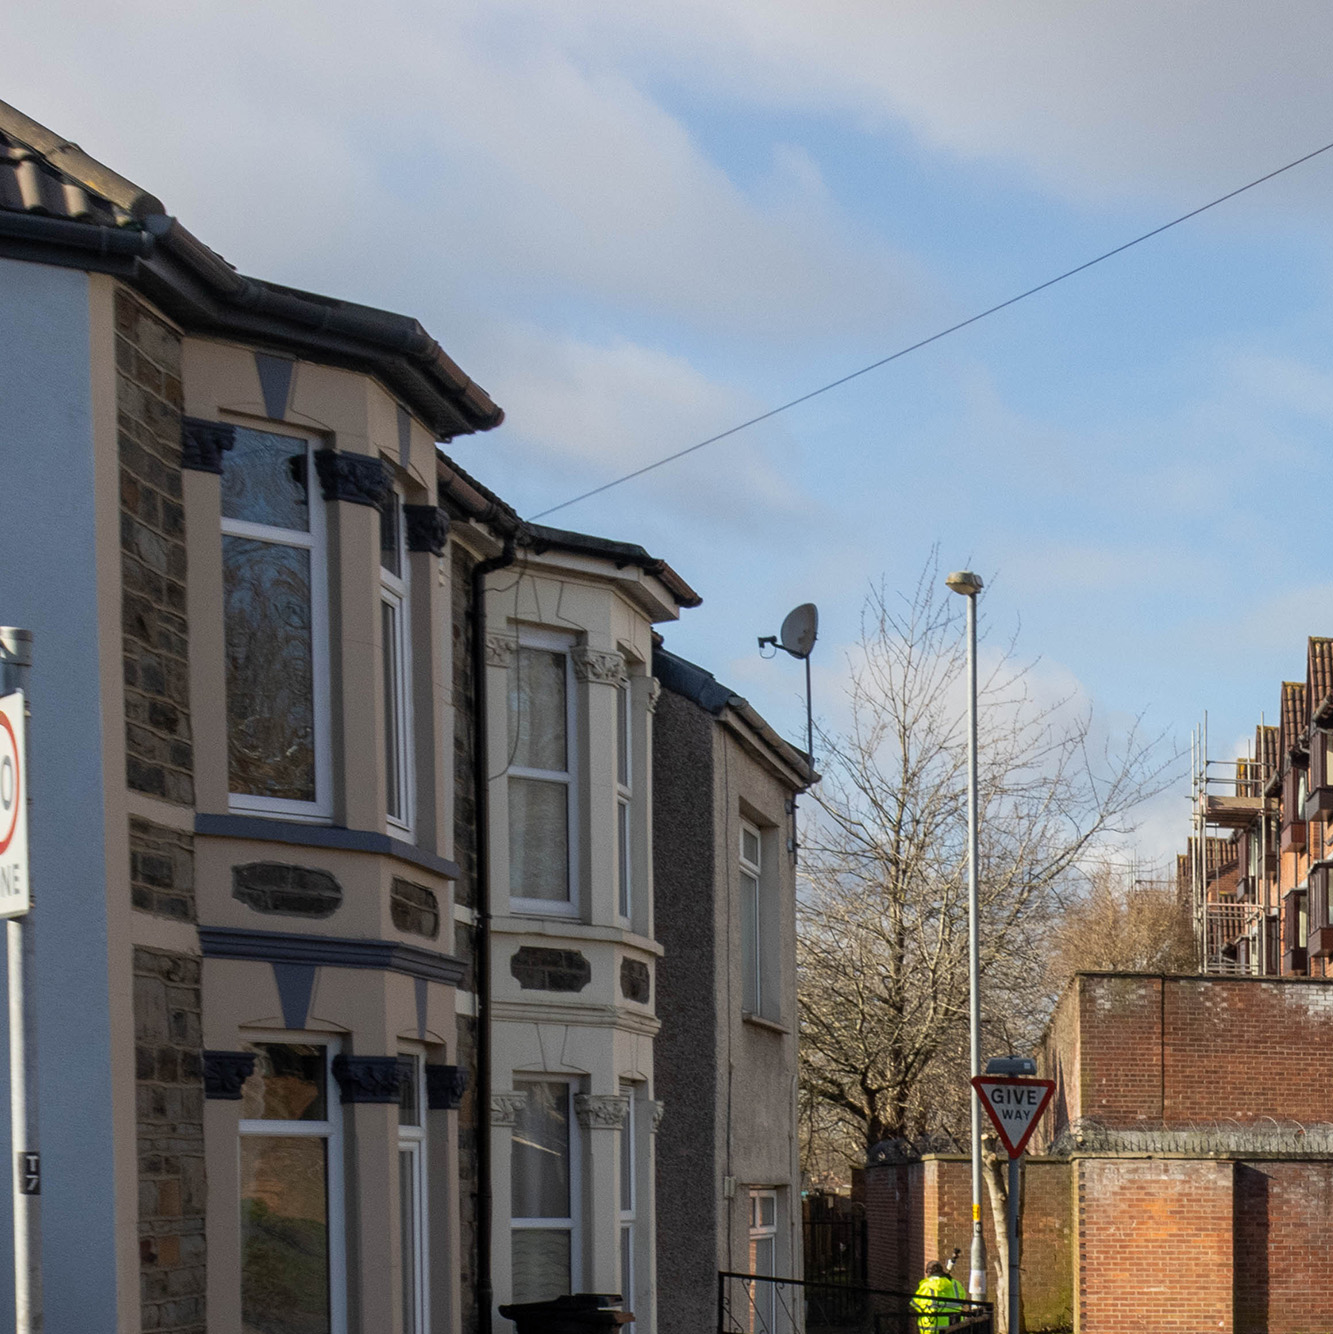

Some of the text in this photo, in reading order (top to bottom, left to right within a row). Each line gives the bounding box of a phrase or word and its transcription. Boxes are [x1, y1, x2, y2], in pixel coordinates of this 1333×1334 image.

[0, 755, 13, 811] 0
[990, 1088, 1037, 1105] GIVE
[1001, 1109, 1030, 1120] WAY
